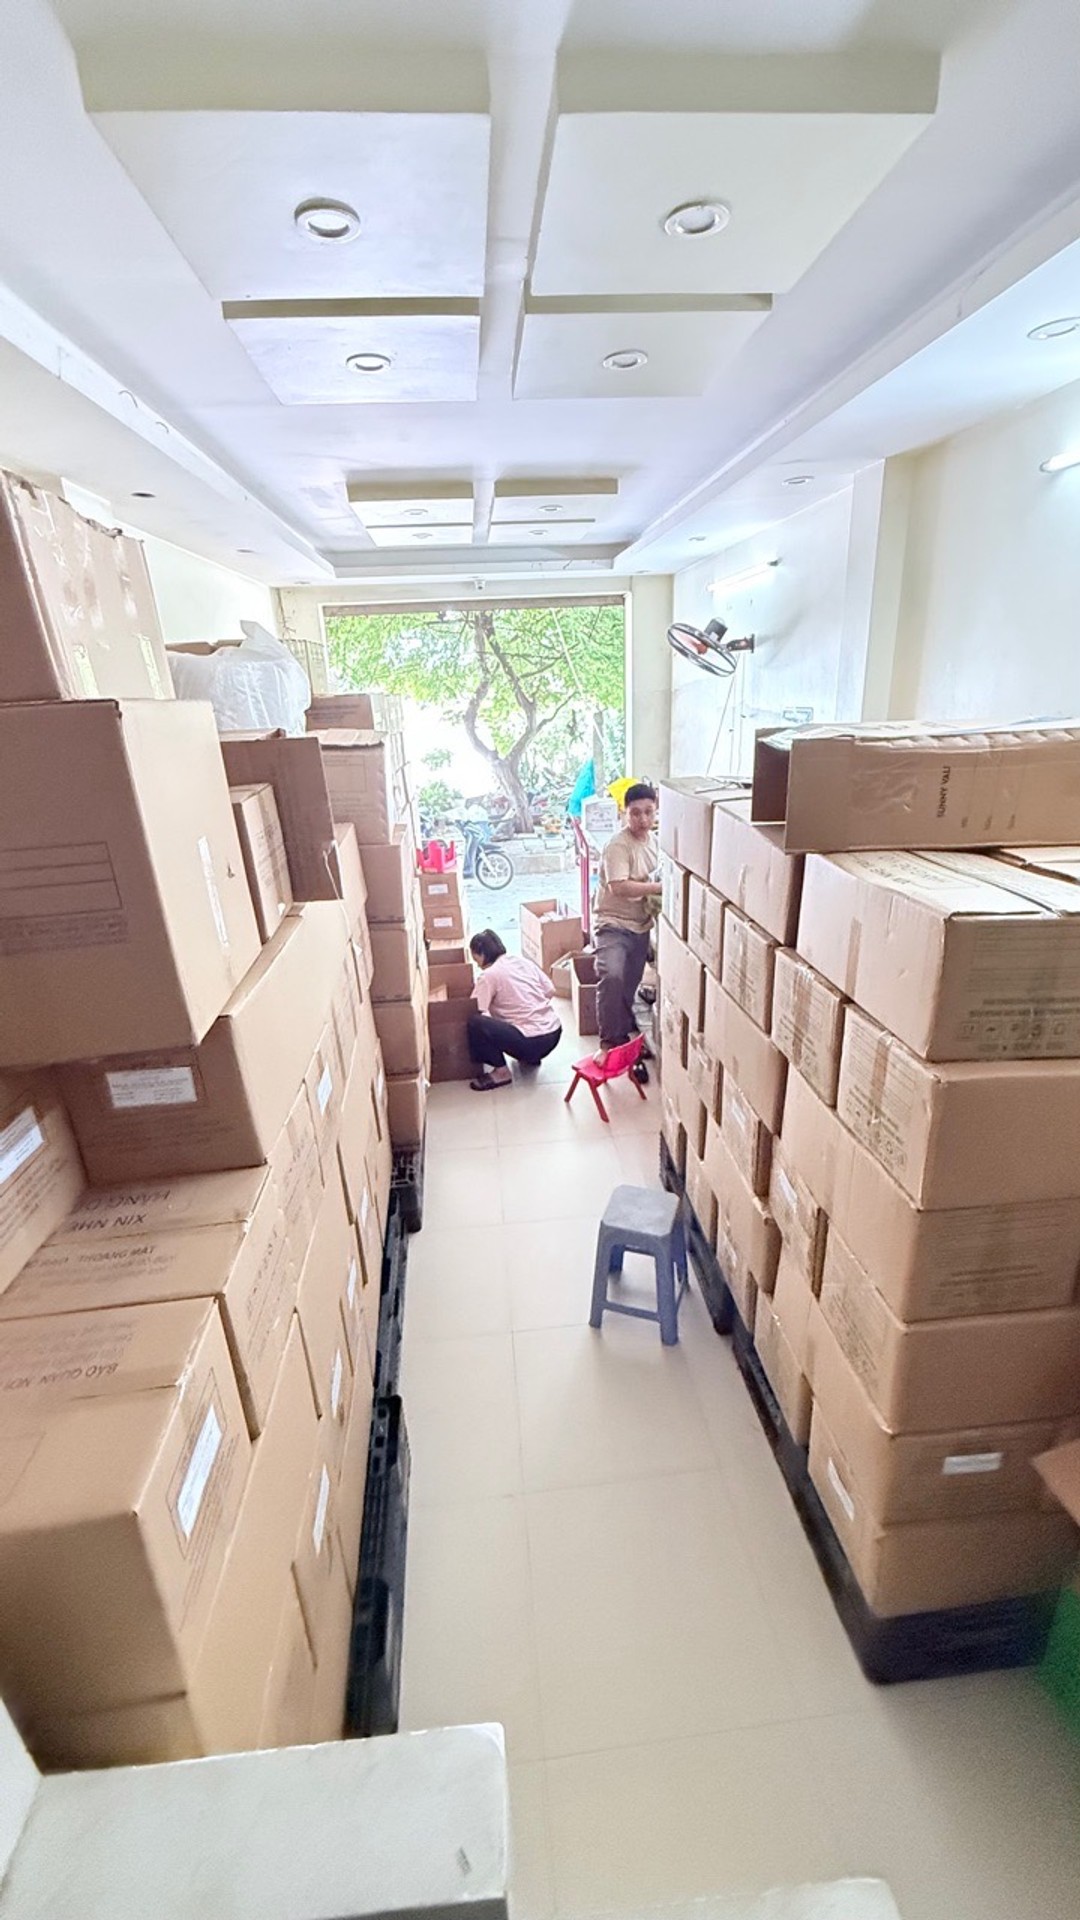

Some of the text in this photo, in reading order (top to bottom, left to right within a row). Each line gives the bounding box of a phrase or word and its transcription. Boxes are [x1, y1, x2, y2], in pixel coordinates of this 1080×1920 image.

[936, 766, 951, 818] SUNNY VALI
[113, 1213, 147, 1227] XIN
